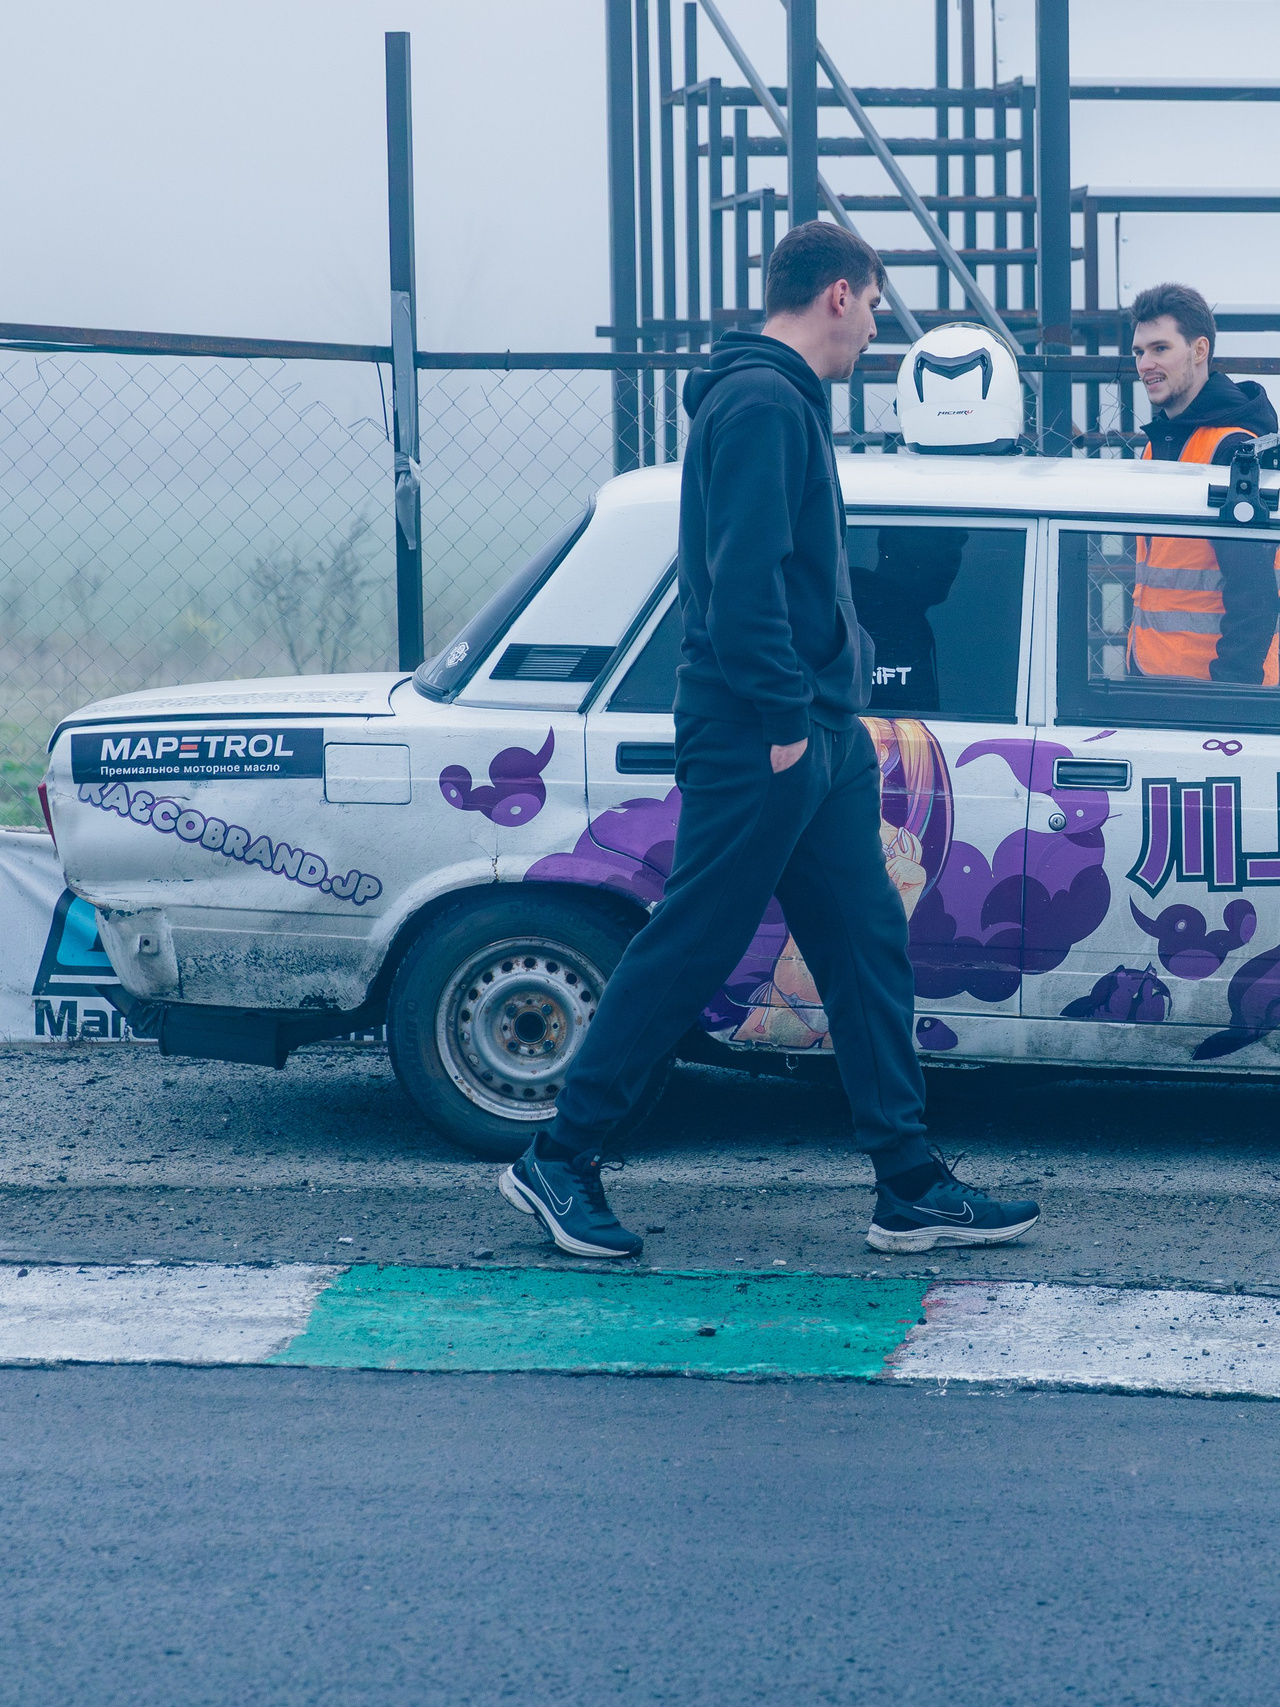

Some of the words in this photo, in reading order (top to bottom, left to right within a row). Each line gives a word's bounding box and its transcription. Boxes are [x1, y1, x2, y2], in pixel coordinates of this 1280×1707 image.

[100, 734, 294, 761] MAPETROL
[100, 764, 180, 777] Премиальное
[183, 763, 241, 775] моторное
[243, 762, 280, 773] масло
